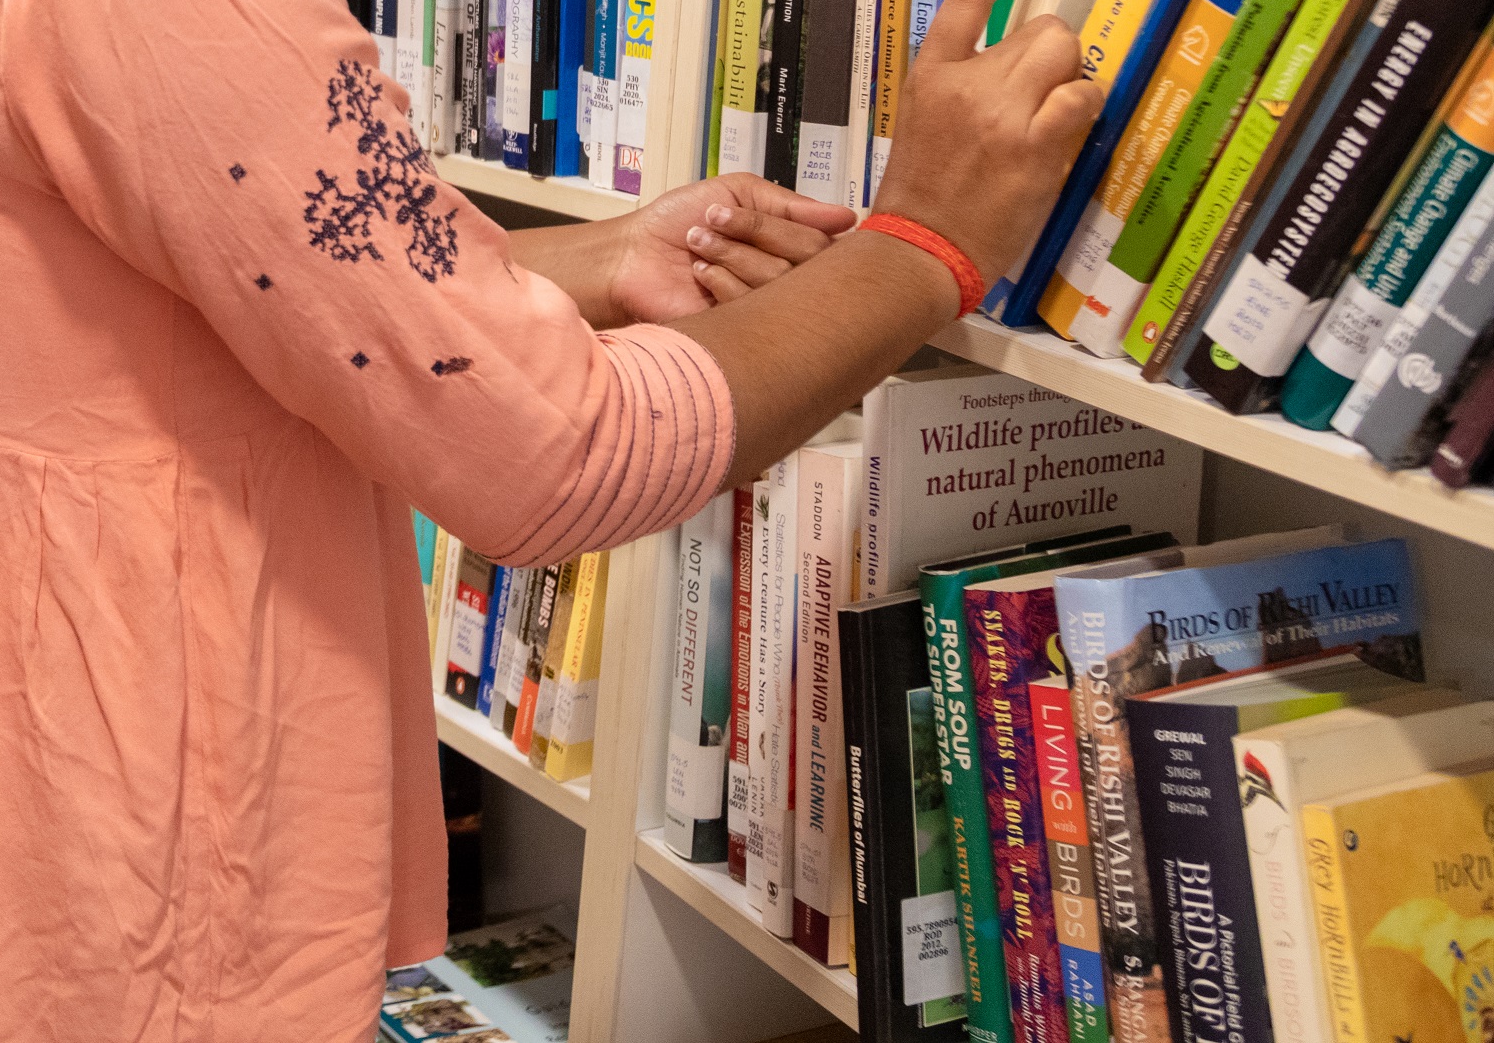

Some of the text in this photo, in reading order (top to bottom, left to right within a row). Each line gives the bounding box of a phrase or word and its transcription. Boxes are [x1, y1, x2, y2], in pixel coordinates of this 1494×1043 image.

[467, 3, 474, 24] OF
[1098, 19, 1115, 40] THE
[464, 27, 474, 69] TIME
[884, 25, 896, 79] Animals
[1353, 20, 1434, 129] ENERGY IN
[622, 91, 641, 100] 2020.
[624, 82, 640, 91] PHY
[626, 74, 639, 83] 530
[775, 67, 788, 135] Mark Everard
[881, 83, 892, 107] Are
[807, 161, 830, 170] 2006
[812, 140, 833, 150] 577
[802, 170, 832, 182] 12031
[1159, 156, 1252, 311] David George Haskell
[920, 408, 1125, 455] Wildlife profiles
[926, 447, 1167, 496] natural phenomena
[813, 482, 823, 542] STADDON
[866, 456, 881, 585] Wildlife profiles
[972, 486, 1119, 531] of Auroville
[775, 513, 786, 573] Statistics
[539, 574, 557, 628] BOMBS
[680, 538, 703, 706] NOT SO DIFFERENT
[756, 526, 769, 718] Every Creature Has Story
[801, 552, 812, 643] Second Edition
[736, 521, 753, 740] Expression of the Emotions in Man
[810, 555, 831, 749] ADAPTIVE BEHAVIOR and
[921, 602, 954, 786] TO SUPERSTAR
[939, 618, 972, 772] FROM SOUP
[983, 609, 1034, 941] SNAKES, DRUGS ROLL
[1081, 611, 1141, 936] BIRDS OF RISHI VALLEY
[849, 744, 868, 905] Butterflies of Mumbai
[1040, 703, 1087, 939] LIVING BIRDS
[952, 815, 982, 1003] KARTIK SHANKER
[918, 947, 950, 962] 002896
[1176, 858, 1227, 1032] BIRDS OF
[1067, 959, 1087, 1041] RAHMANI
[1079, 978, 1097, 1028] ASAD
